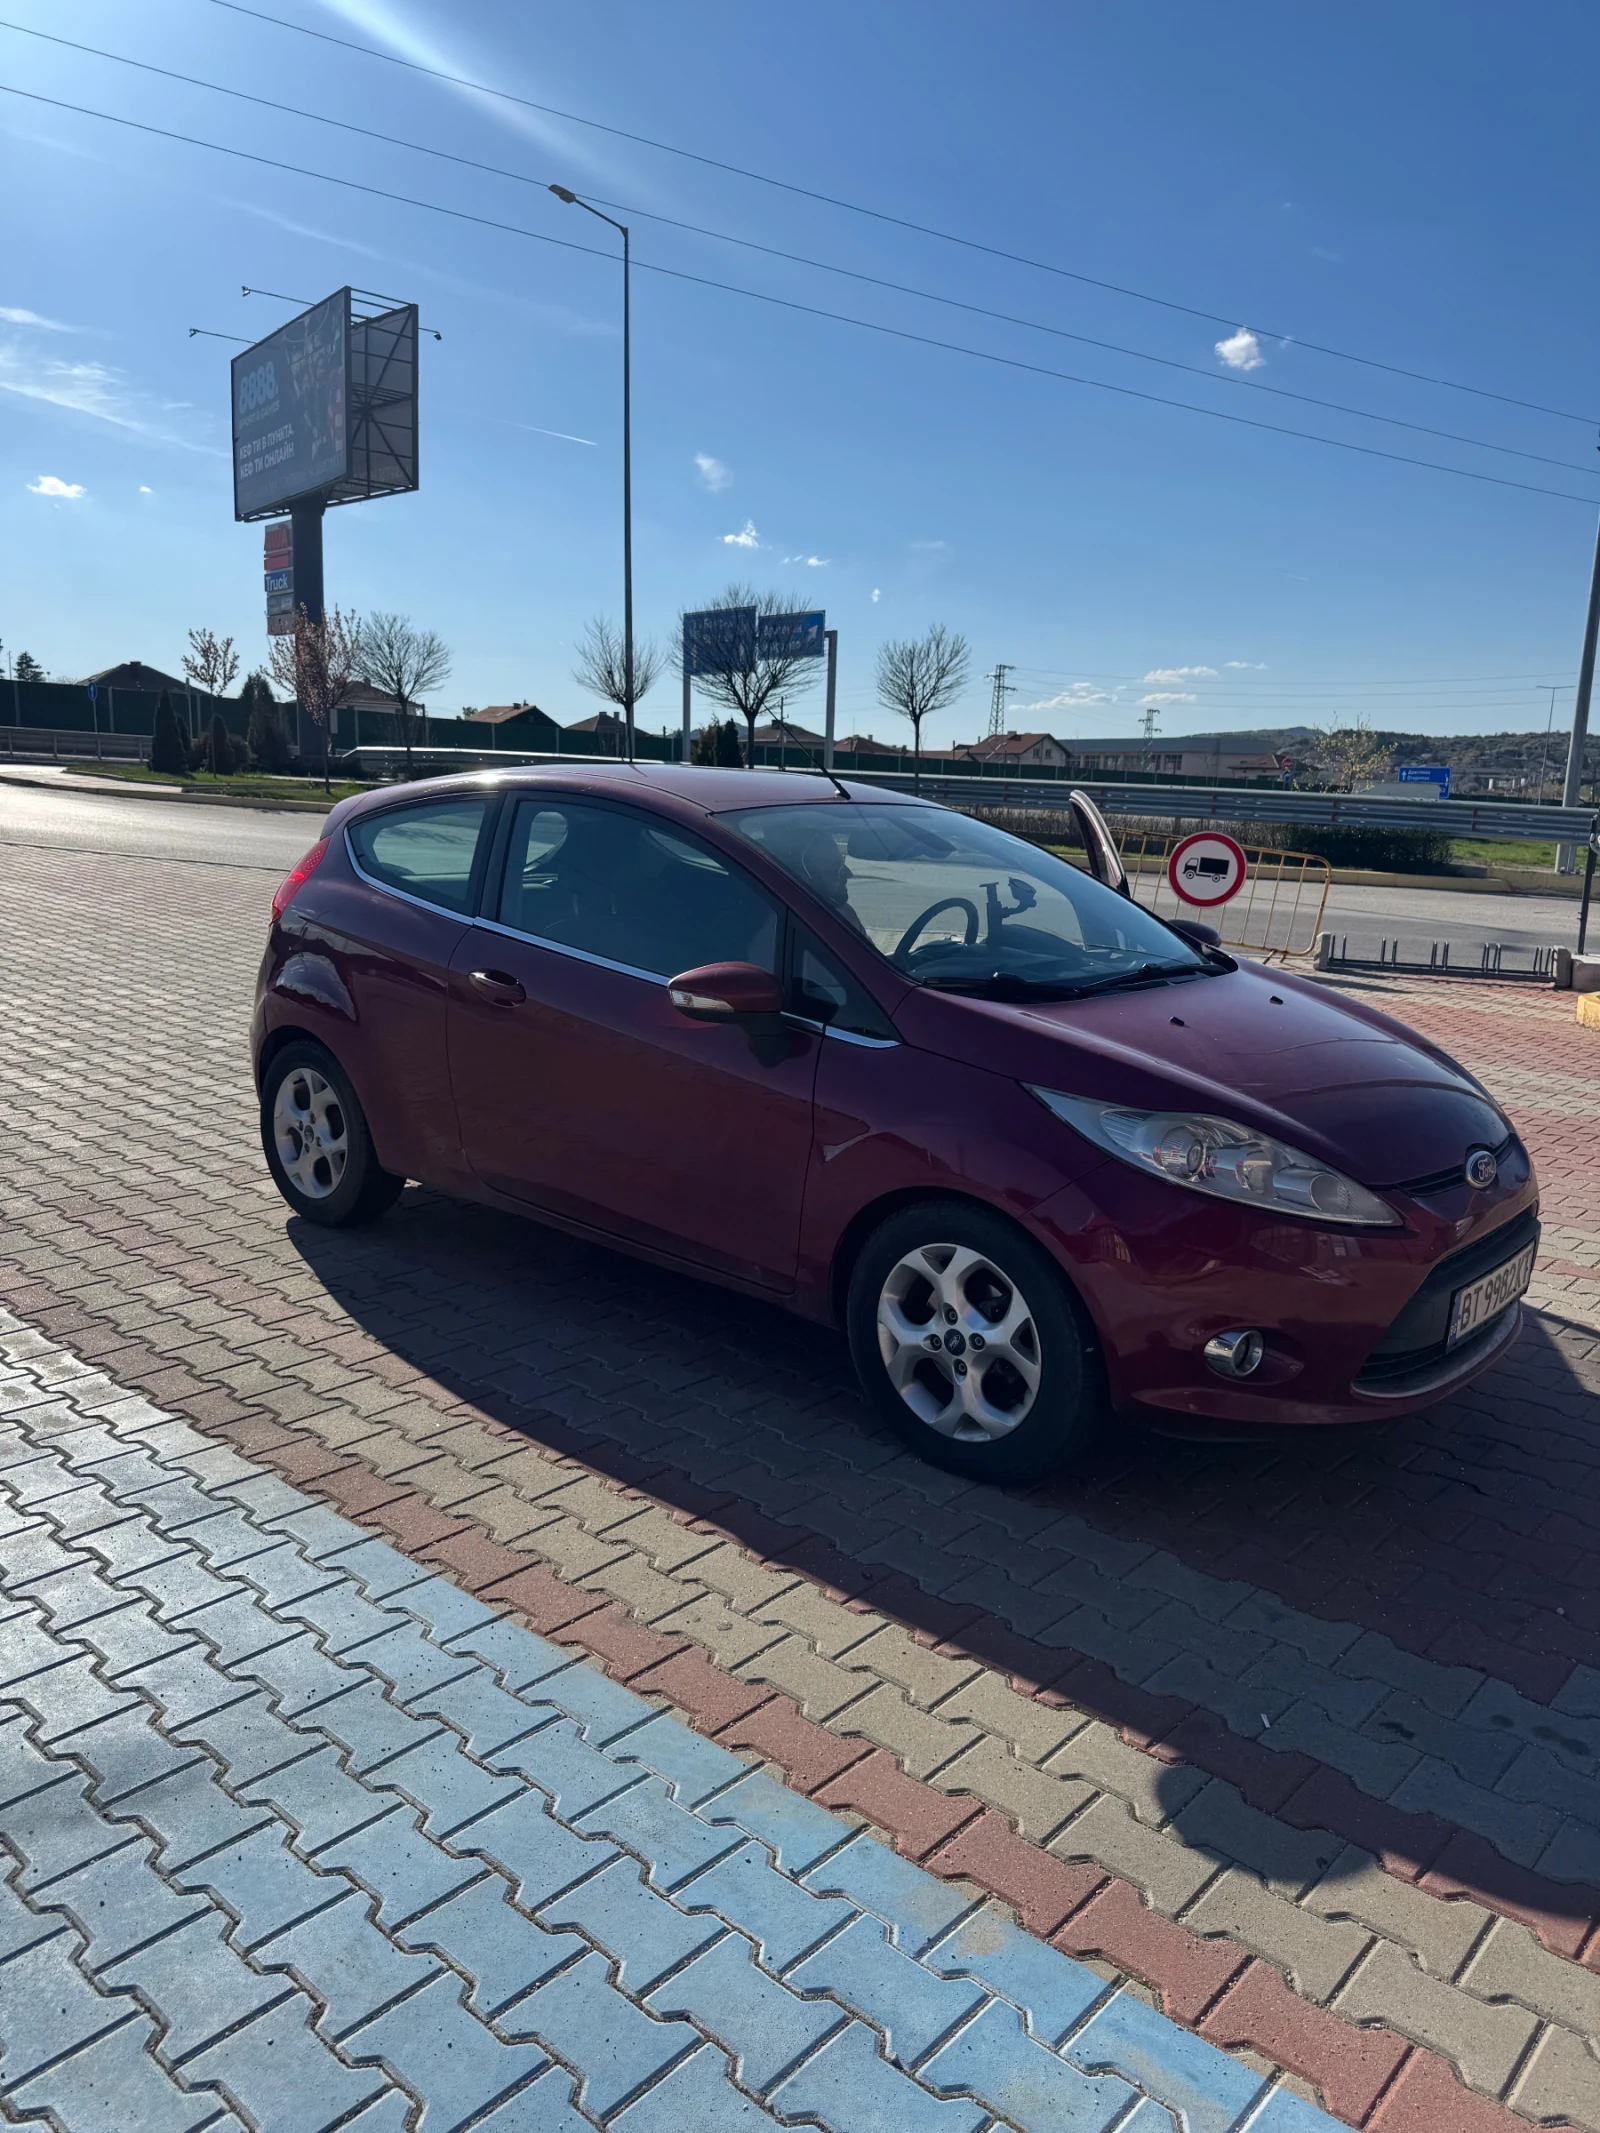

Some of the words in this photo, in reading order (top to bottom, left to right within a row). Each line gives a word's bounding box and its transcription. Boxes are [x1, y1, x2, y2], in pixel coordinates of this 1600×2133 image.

[239, 443, 252, 460] КЕФ
[252, 438, 261, 454] ТИ
[262, 435, 267, 450] В
[240, 461, 253, 479] КЕФ
[254, 456, 263, 473] ТИ
[265, 573, 288, 591] Truck
